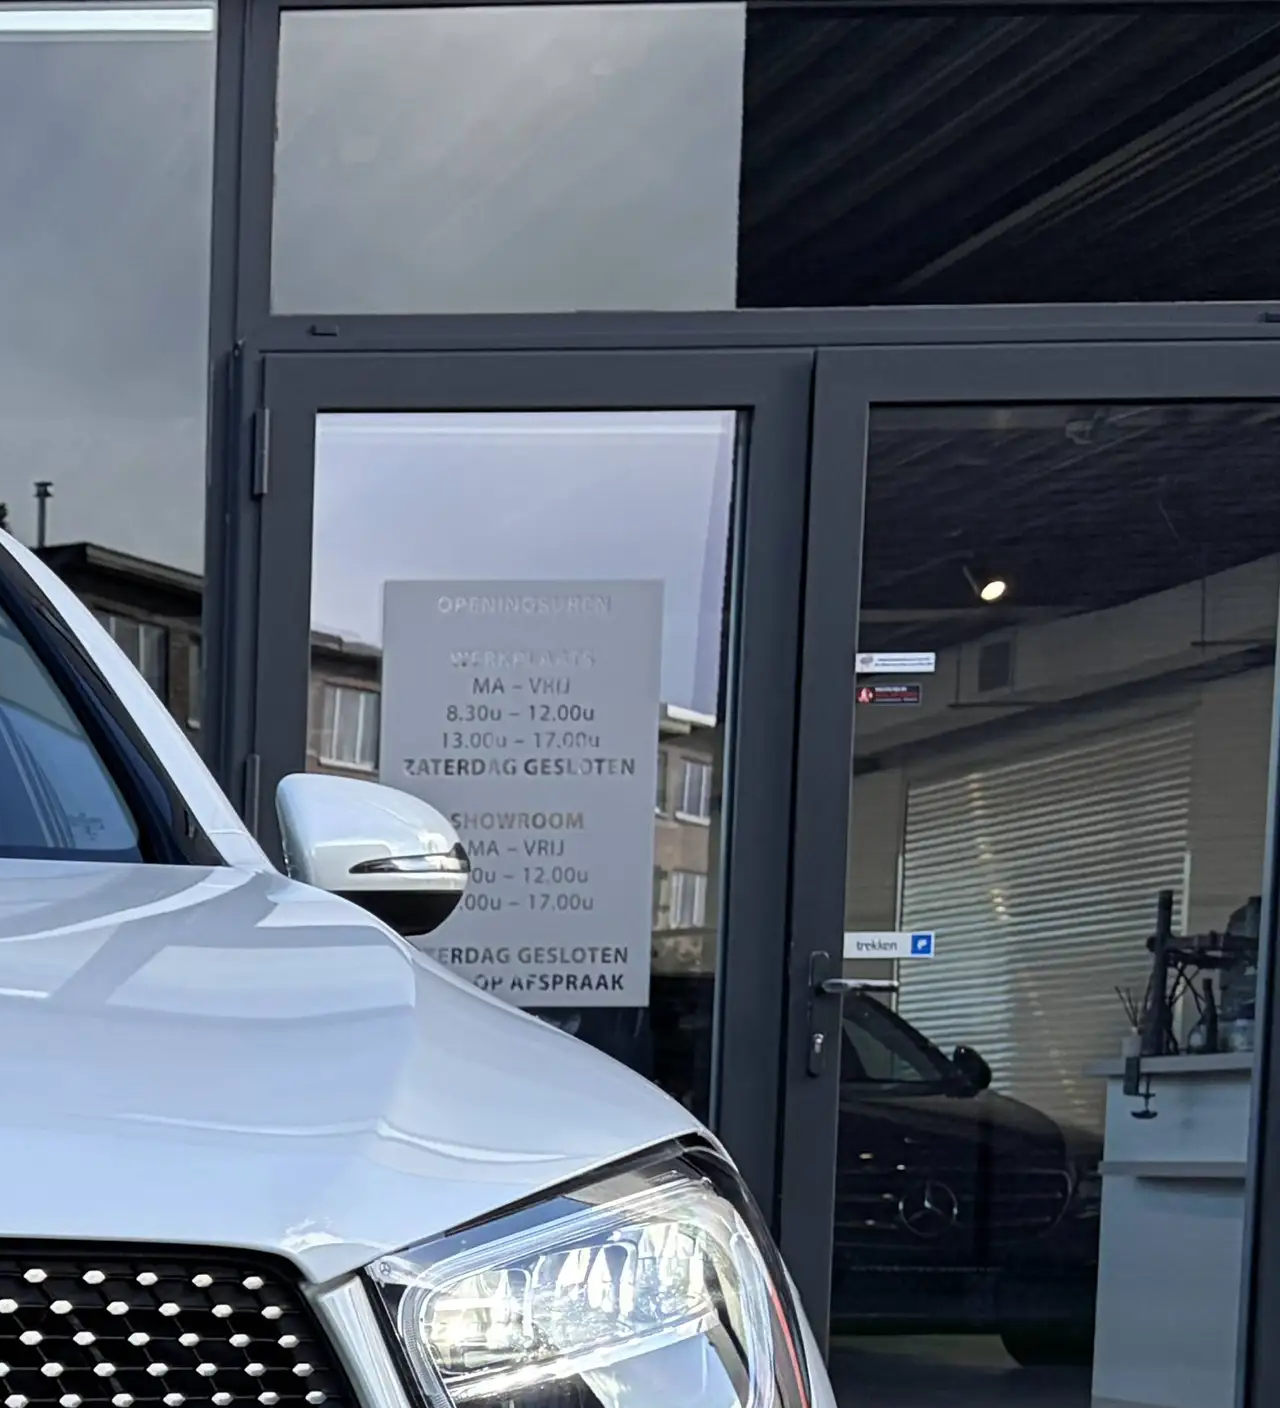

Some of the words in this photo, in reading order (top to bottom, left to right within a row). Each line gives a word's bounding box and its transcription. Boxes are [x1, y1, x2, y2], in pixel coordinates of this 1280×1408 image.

[438, 596, 612, 613] OPENINGSUREN
[473, 678, 505, 694] MA
[529, 678, 570, 694] VRIJ
[446, 704, 502, 721] 8.30u
[529, 704, 595, 721] 12.00u
[443, 732, 507, 749] 13.00u
[533, 732, 600, 749] 17.00u
[403, 758, 517, 776] ZATERDAG
[524, 758, 636, 776] GESLOTEN
[451, 812, 585, 830] SHOWROOM
[468, 840, 500, 857] MA
[523, 840, 566, 857] VRIJ
[524, 867, 589, 884] 12.00u
[529, 894, 594, 911] 17.00u
[518, 947, 628, 964] GESLOTEN
[510, 974, 624, 991] AFSPRAAK
